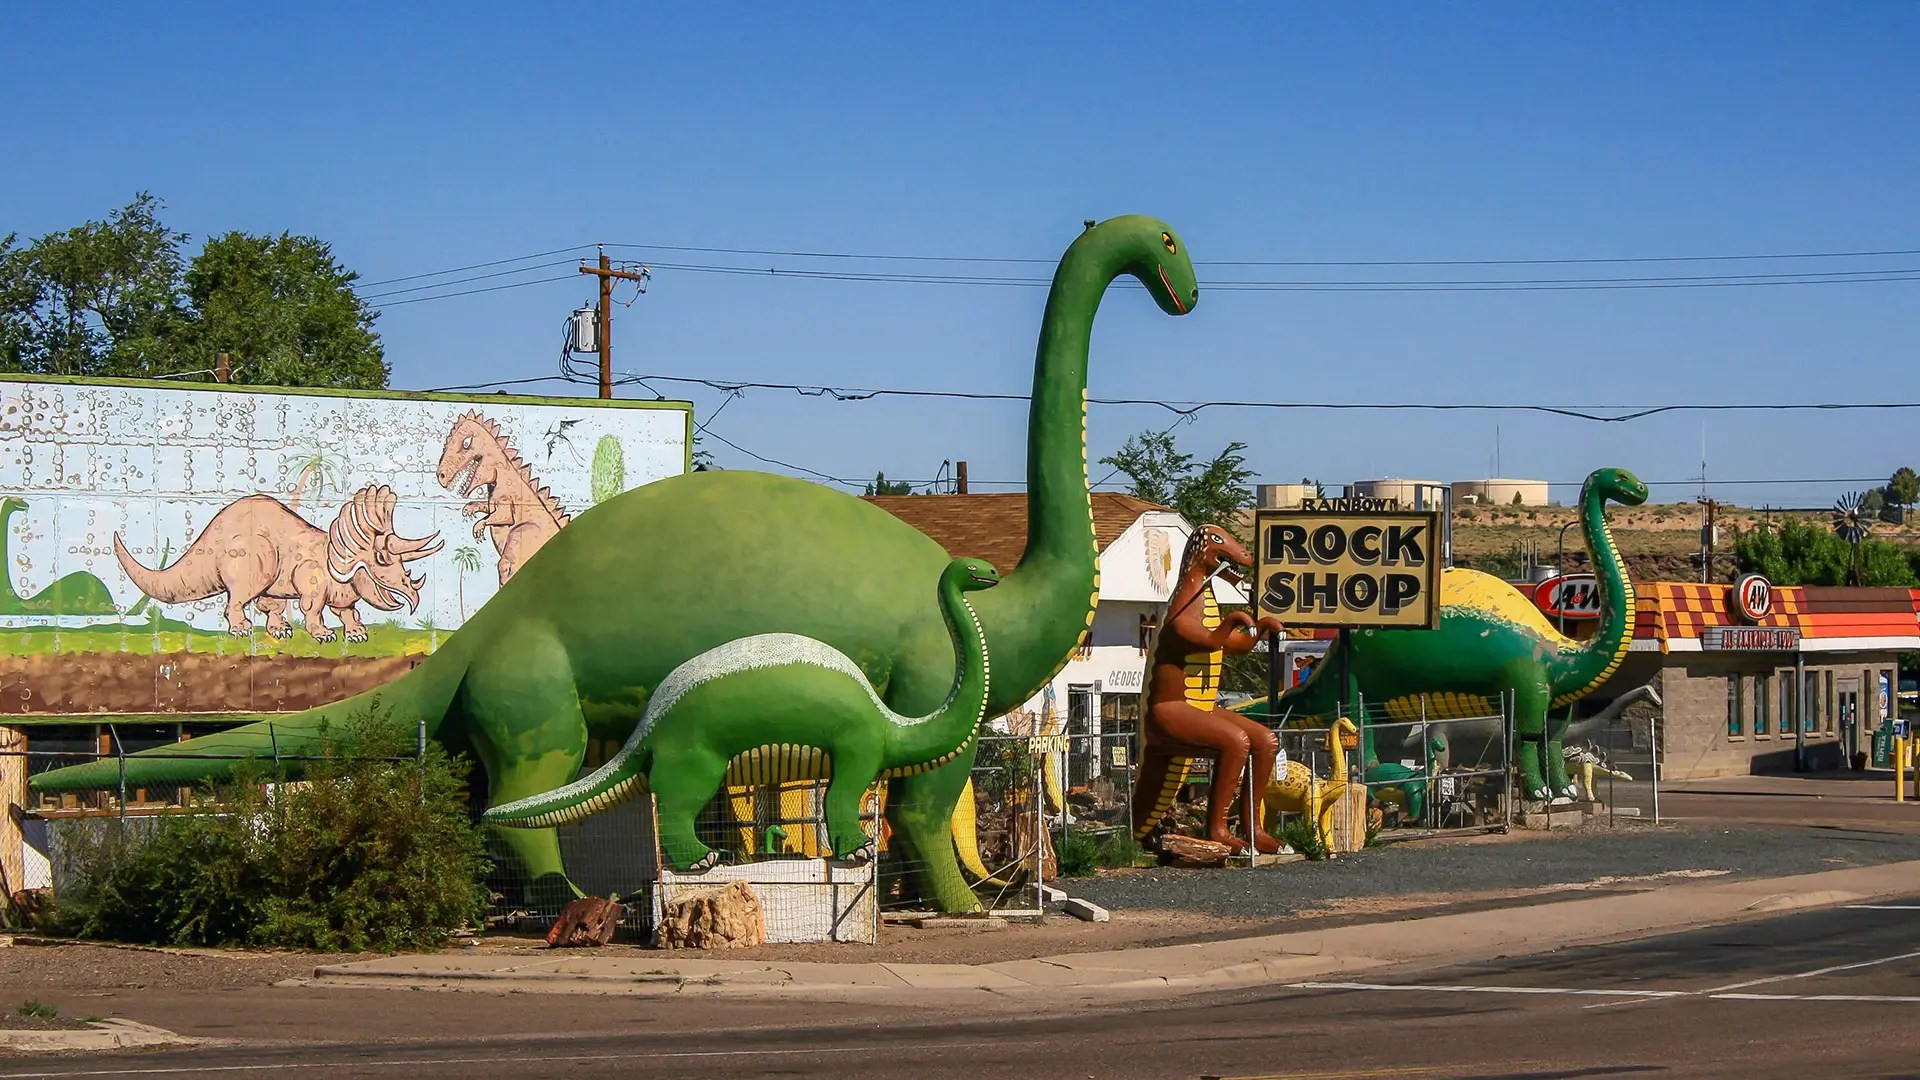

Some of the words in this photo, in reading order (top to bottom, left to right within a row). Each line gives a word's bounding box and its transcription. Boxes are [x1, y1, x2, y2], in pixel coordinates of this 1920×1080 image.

[1264, 524, 1426, 567] ROCK
[1259, 571, 1421, 616] SHOP
[1108, 670, 1142, 687] GEODES
[1028, 735, 1071, 754] PARKING
